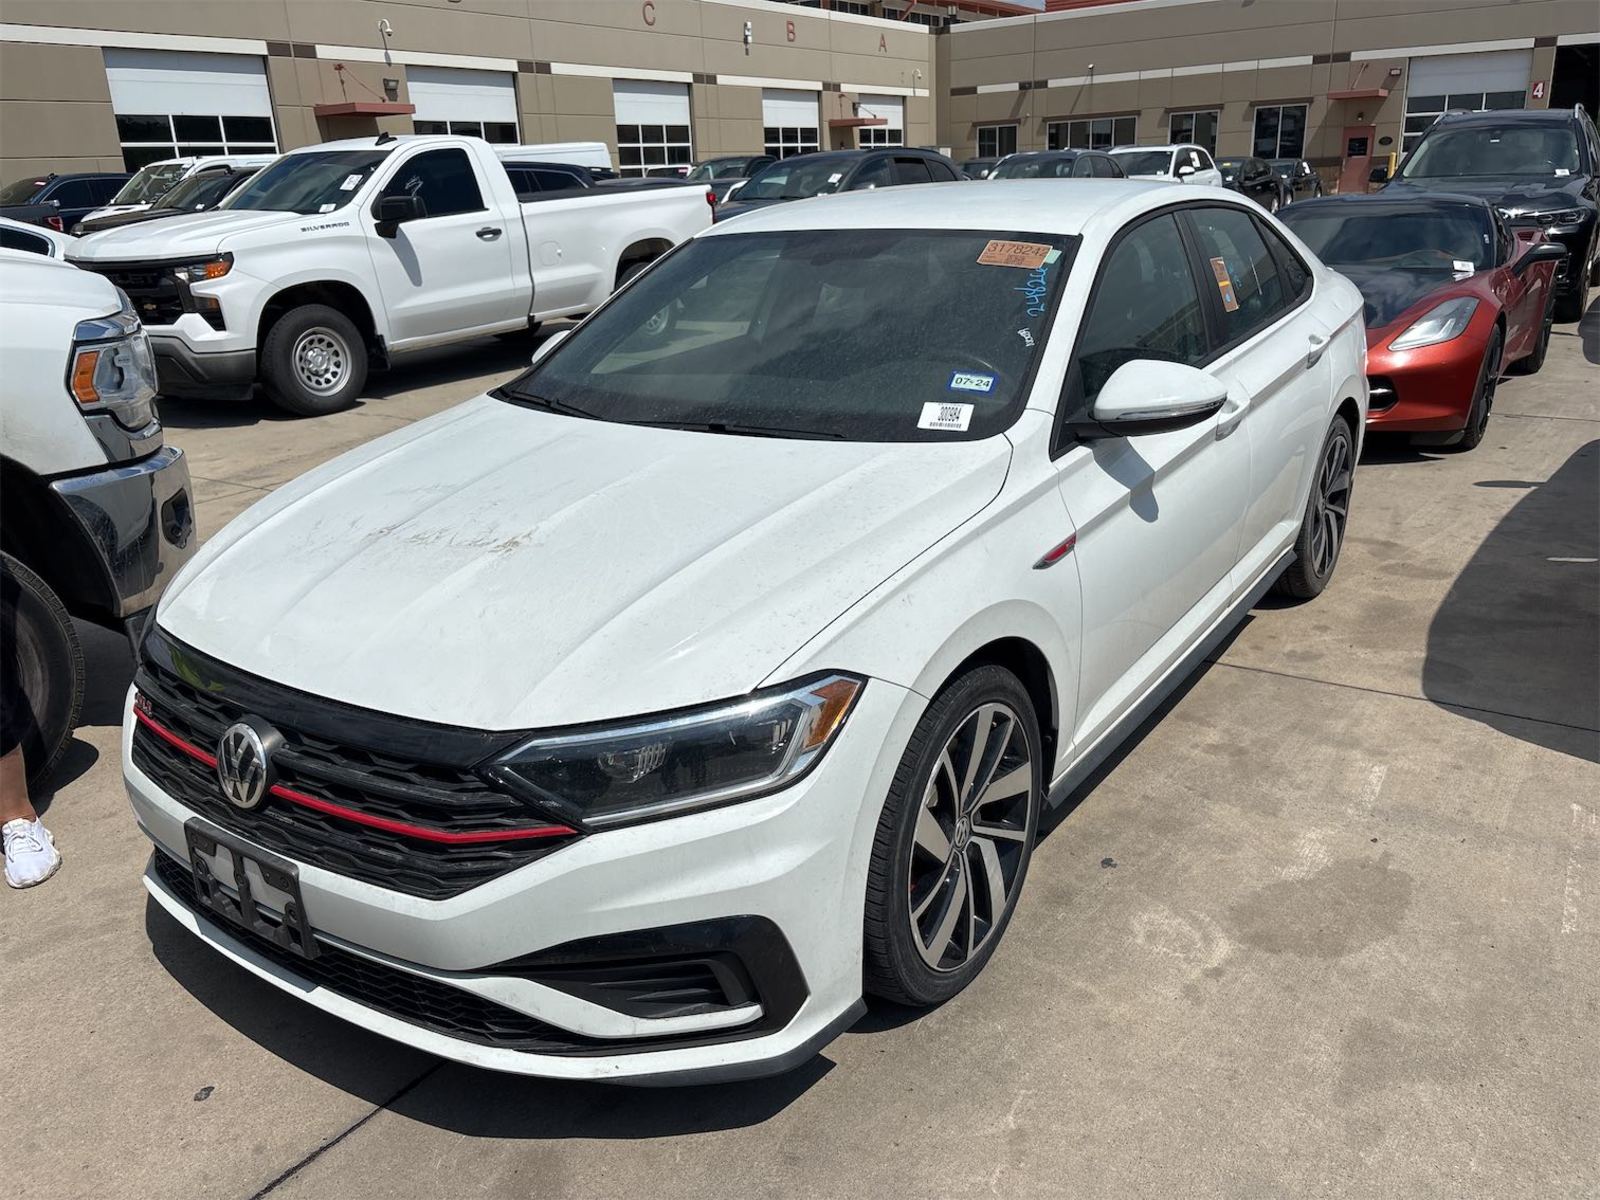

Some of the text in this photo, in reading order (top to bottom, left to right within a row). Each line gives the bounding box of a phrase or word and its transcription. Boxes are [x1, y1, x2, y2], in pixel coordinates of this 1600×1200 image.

[642, 1, 656, 26] C
[786, 21, 796, 42] B
[879, 34, 888, 53] A
[1533, 82, 1544, 98] 4
[300, 221, 350, 232] SILVERADO
